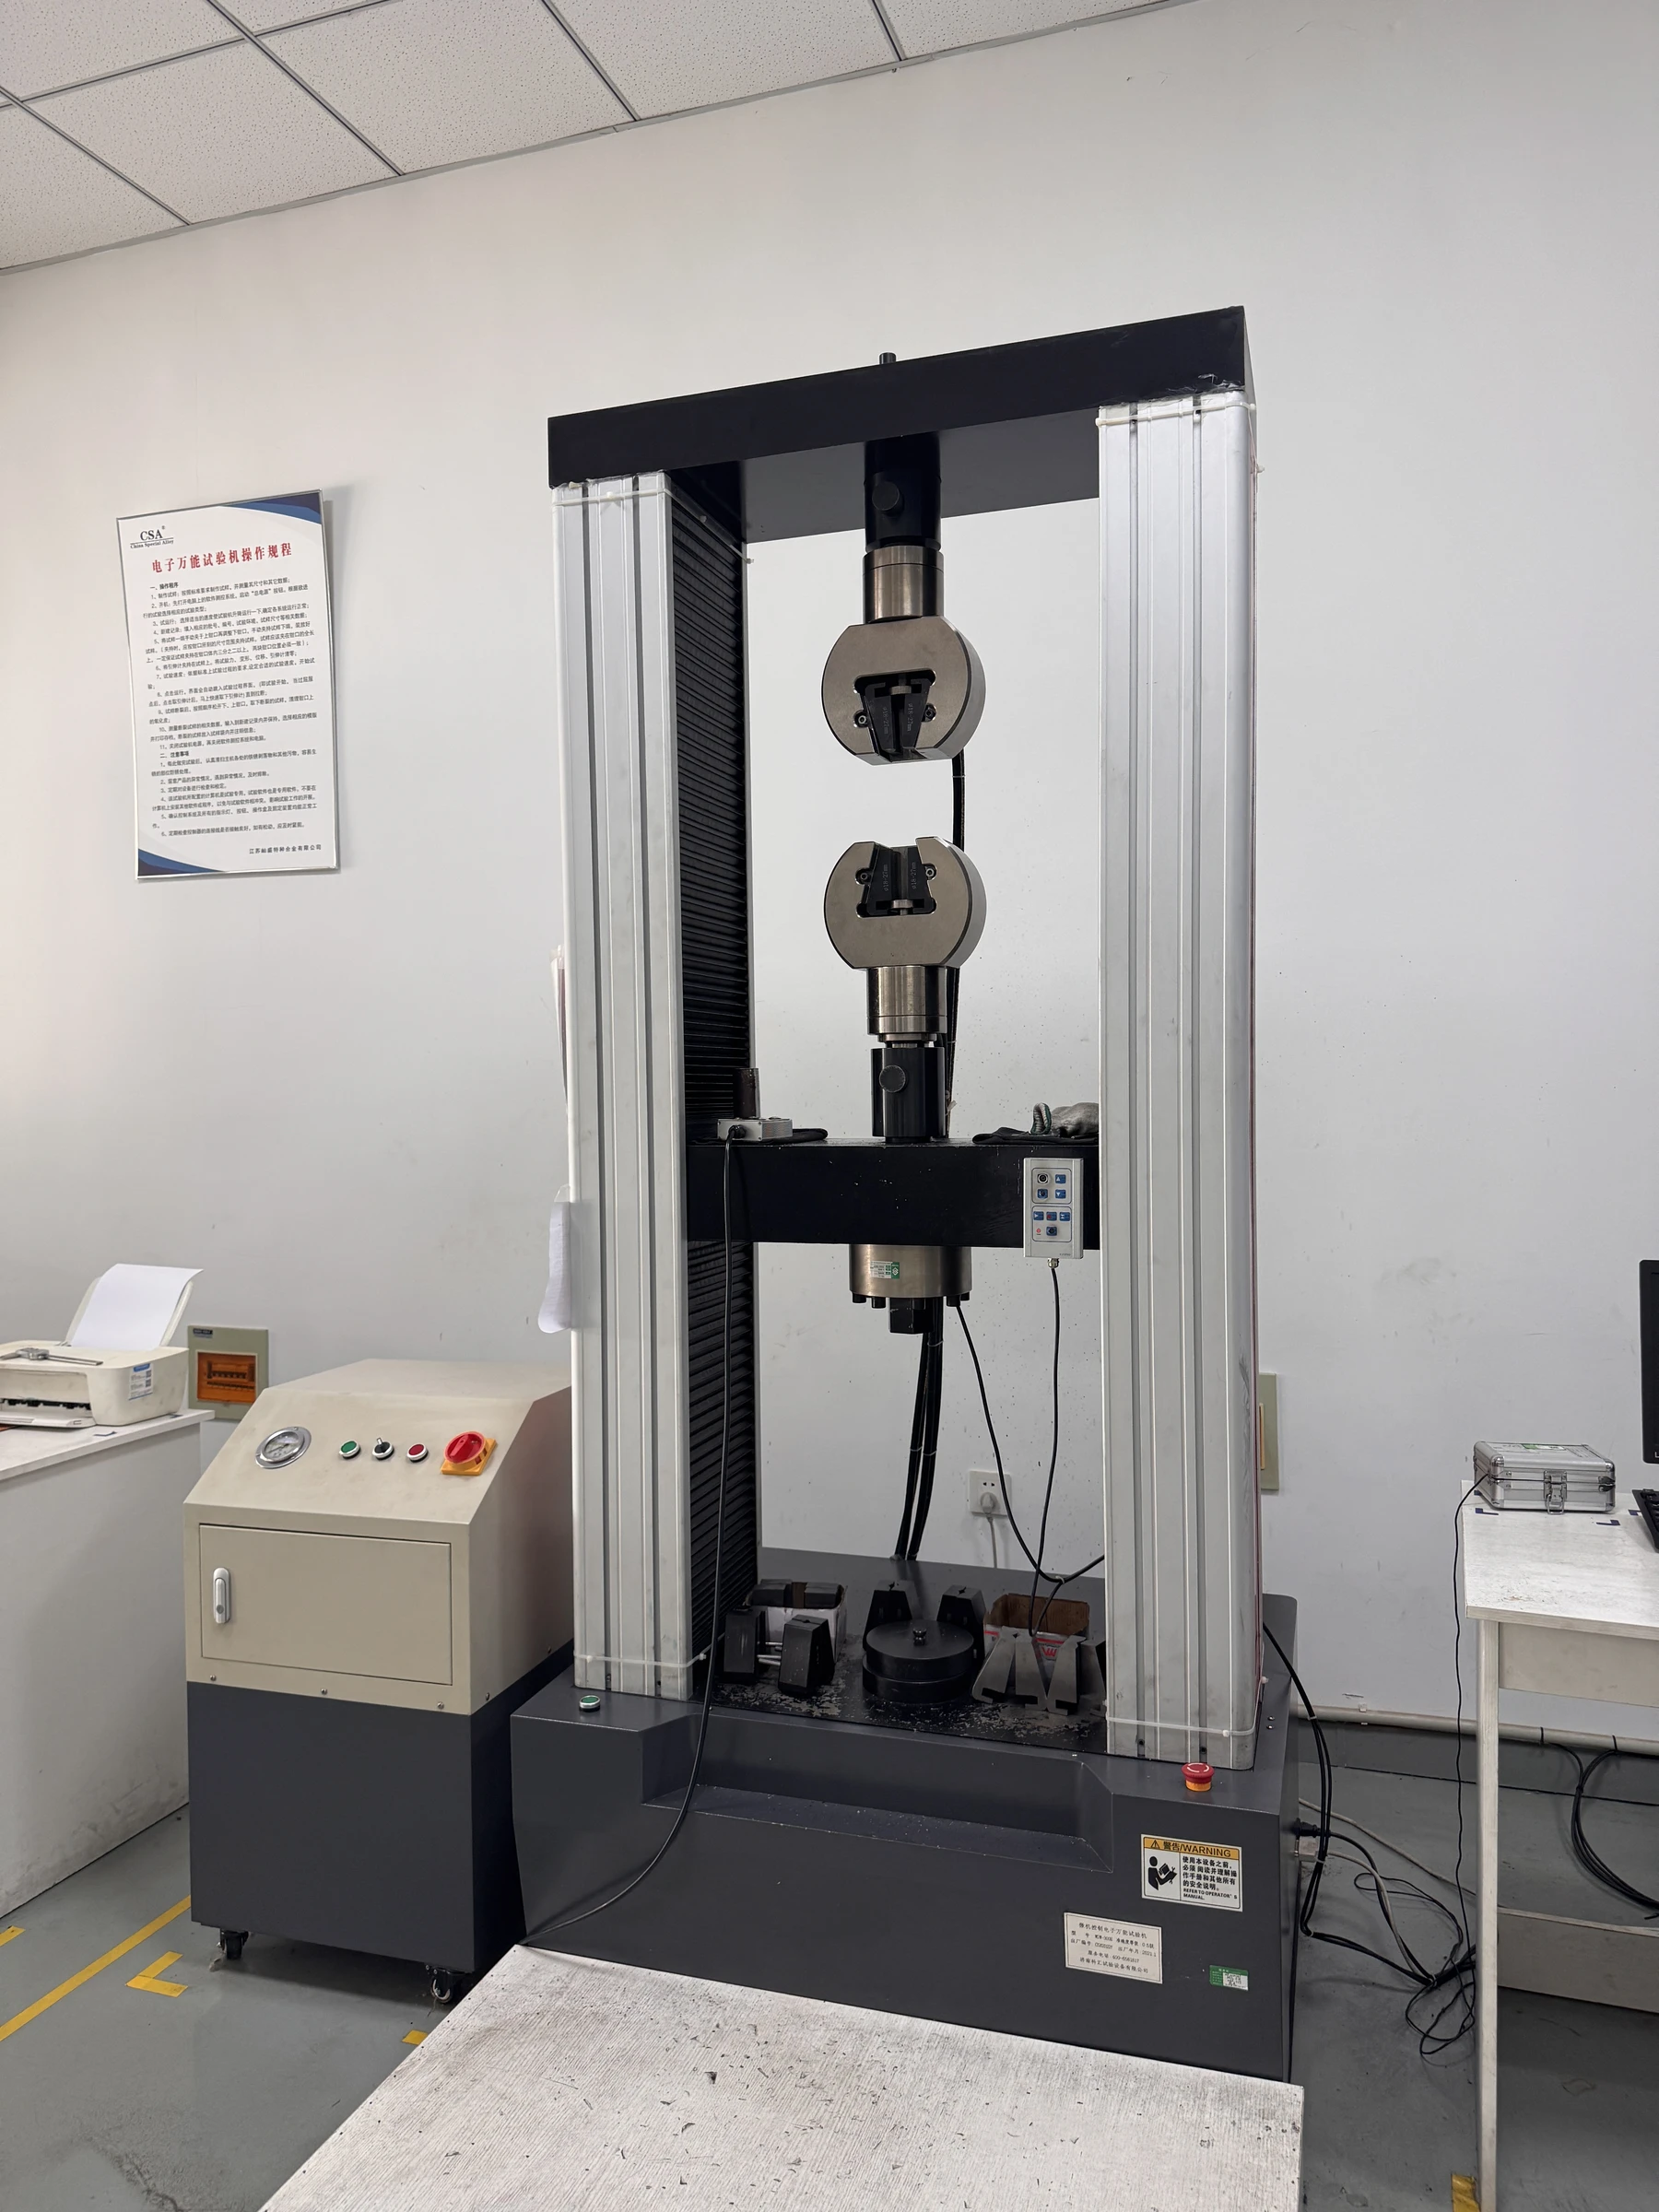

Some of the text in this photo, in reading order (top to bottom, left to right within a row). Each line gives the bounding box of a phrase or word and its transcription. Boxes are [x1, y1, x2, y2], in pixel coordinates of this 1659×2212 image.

[140, 529, 163, 541] CSA
[152, 543, 292, 573] 电子万能试验机操作规程
[150, 582, 179, 590] 一、操作程序
[1163, 1841, 1231, 1857] 警告/WARNING
[1182, 1872, 1236, 1885] 作手册和其他所有
[1182, 1879, 1219, 1891] 的安全说明。
[1078, 1922, 1147, 1939] 微机控制电子万能试验机
